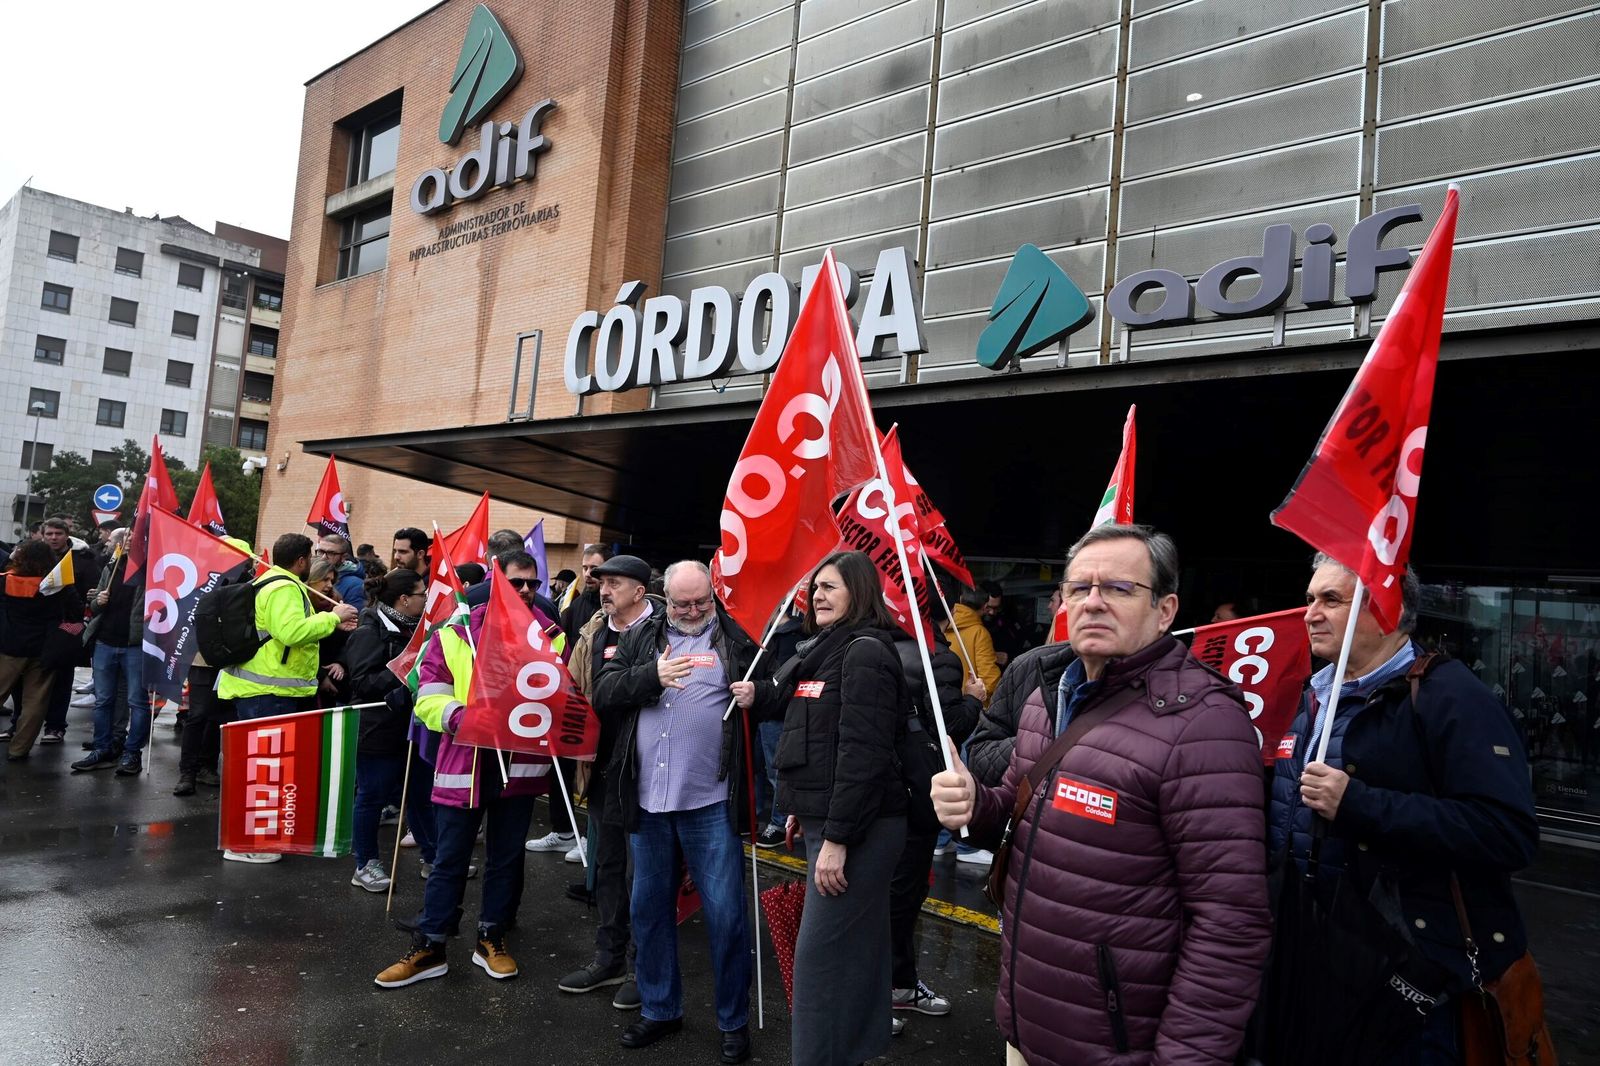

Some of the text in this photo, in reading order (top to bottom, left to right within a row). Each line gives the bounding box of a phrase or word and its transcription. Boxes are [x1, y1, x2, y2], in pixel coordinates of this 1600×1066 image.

[410, 98, 557, 215] adif
[409, 204, 560, 262] INFRAESTRUCTURAS FERROVIARIAS
[438, 201, 526, 240] ADMINISTRADOR DE
[1107, 203, 1423, 329] adif
[1057, 782, 1101, 808] CCOO
[1558, 785, 1588, 795] tiendas
[1085, 806, 1112, 819] Córdoba
